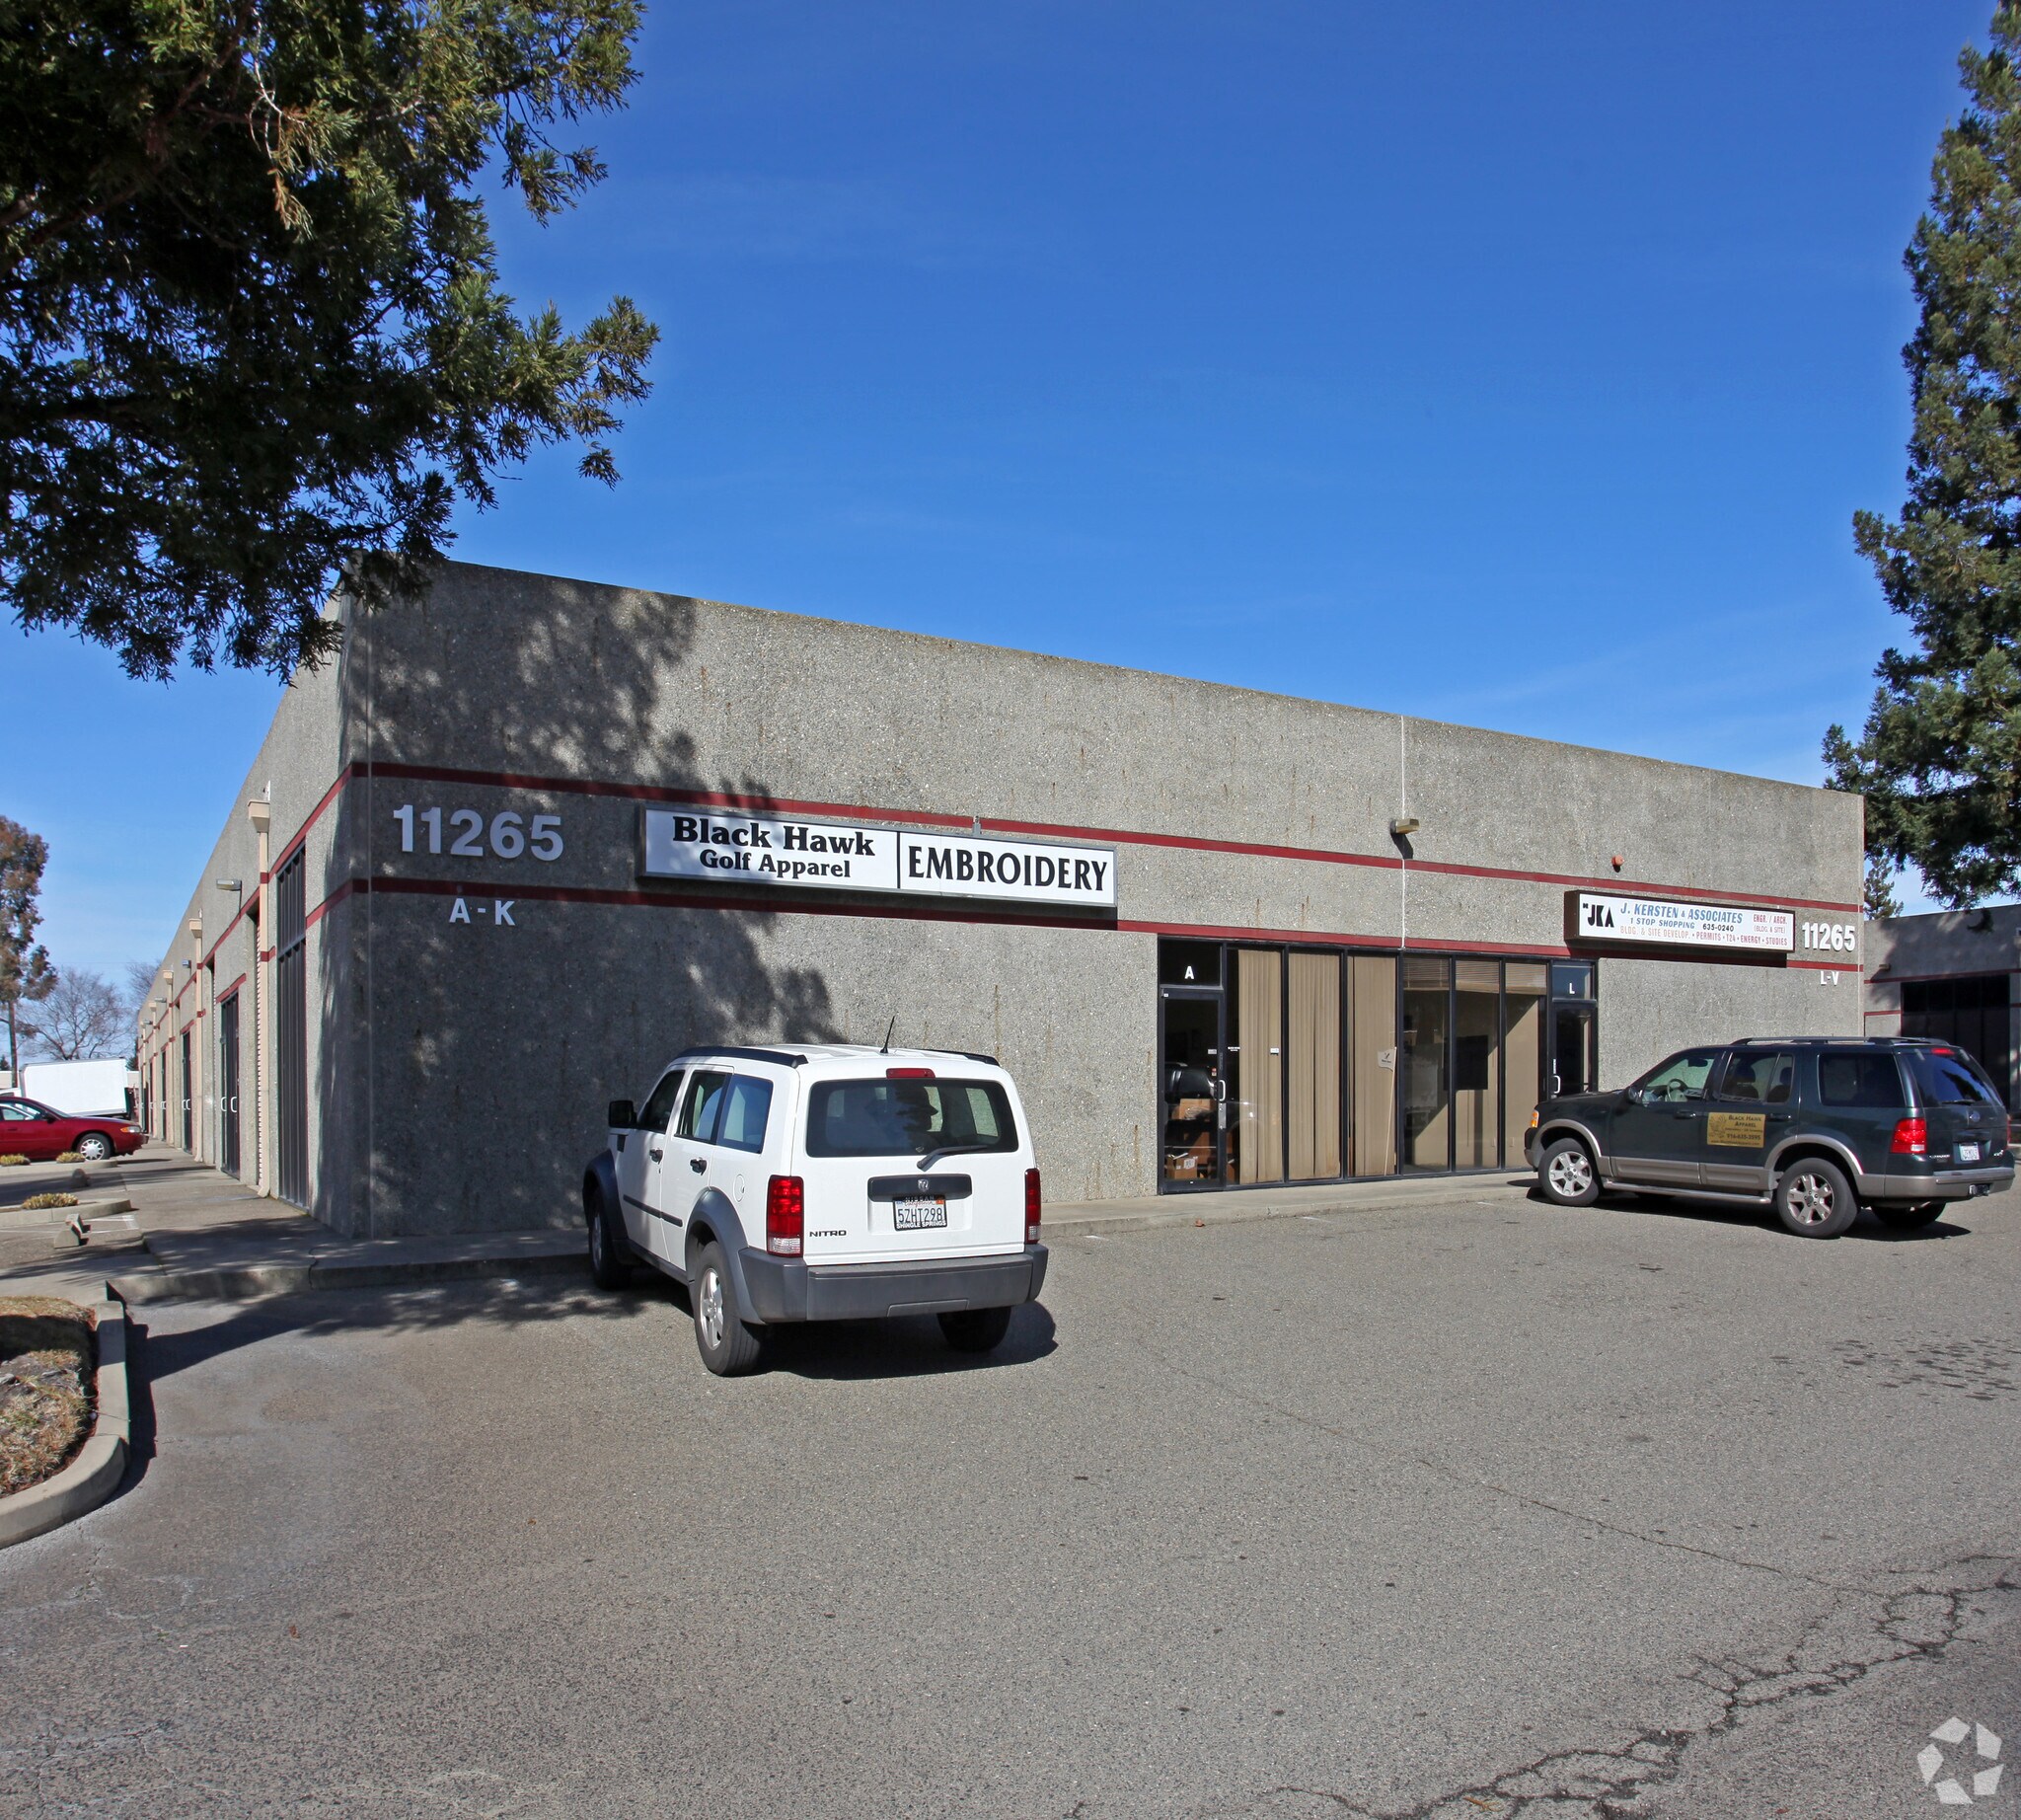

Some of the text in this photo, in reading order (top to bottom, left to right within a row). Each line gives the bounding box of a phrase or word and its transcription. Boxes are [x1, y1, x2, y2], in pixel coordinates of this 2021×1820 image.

[393, 804, 563, 861] 11265
[672, 816, 875, 856] Black Hawk
[699, 849, 851, 878] Golf Apparel
[908, 846, 1107, 890] EMBROIDERY
[1588, 904, 1614, 928] JKA
[1620, 902, 1630, 914] J.
[1634, 904, 1679, 918] KERSTEN
[1687, 909, 1743, 924] ASSOCIATES
[1659, 920, 1695, 929] SHOPPING
[1702, 923, 1735, 932] 635-0240
[1648, 928, 1662, 937] SITE
[1696, 931, 1721, 941] PERMITS
[1740, 935, 1760, 944] ENERGY
[1765, 937, 1788, 947] STUDIES
[1802, 922, 1856, 951] 11265
[1184, 966, 1195, 980] A
[1569, 983, 1576, 995] L
[898, 1208, 942, 1224] 5ZHT298
